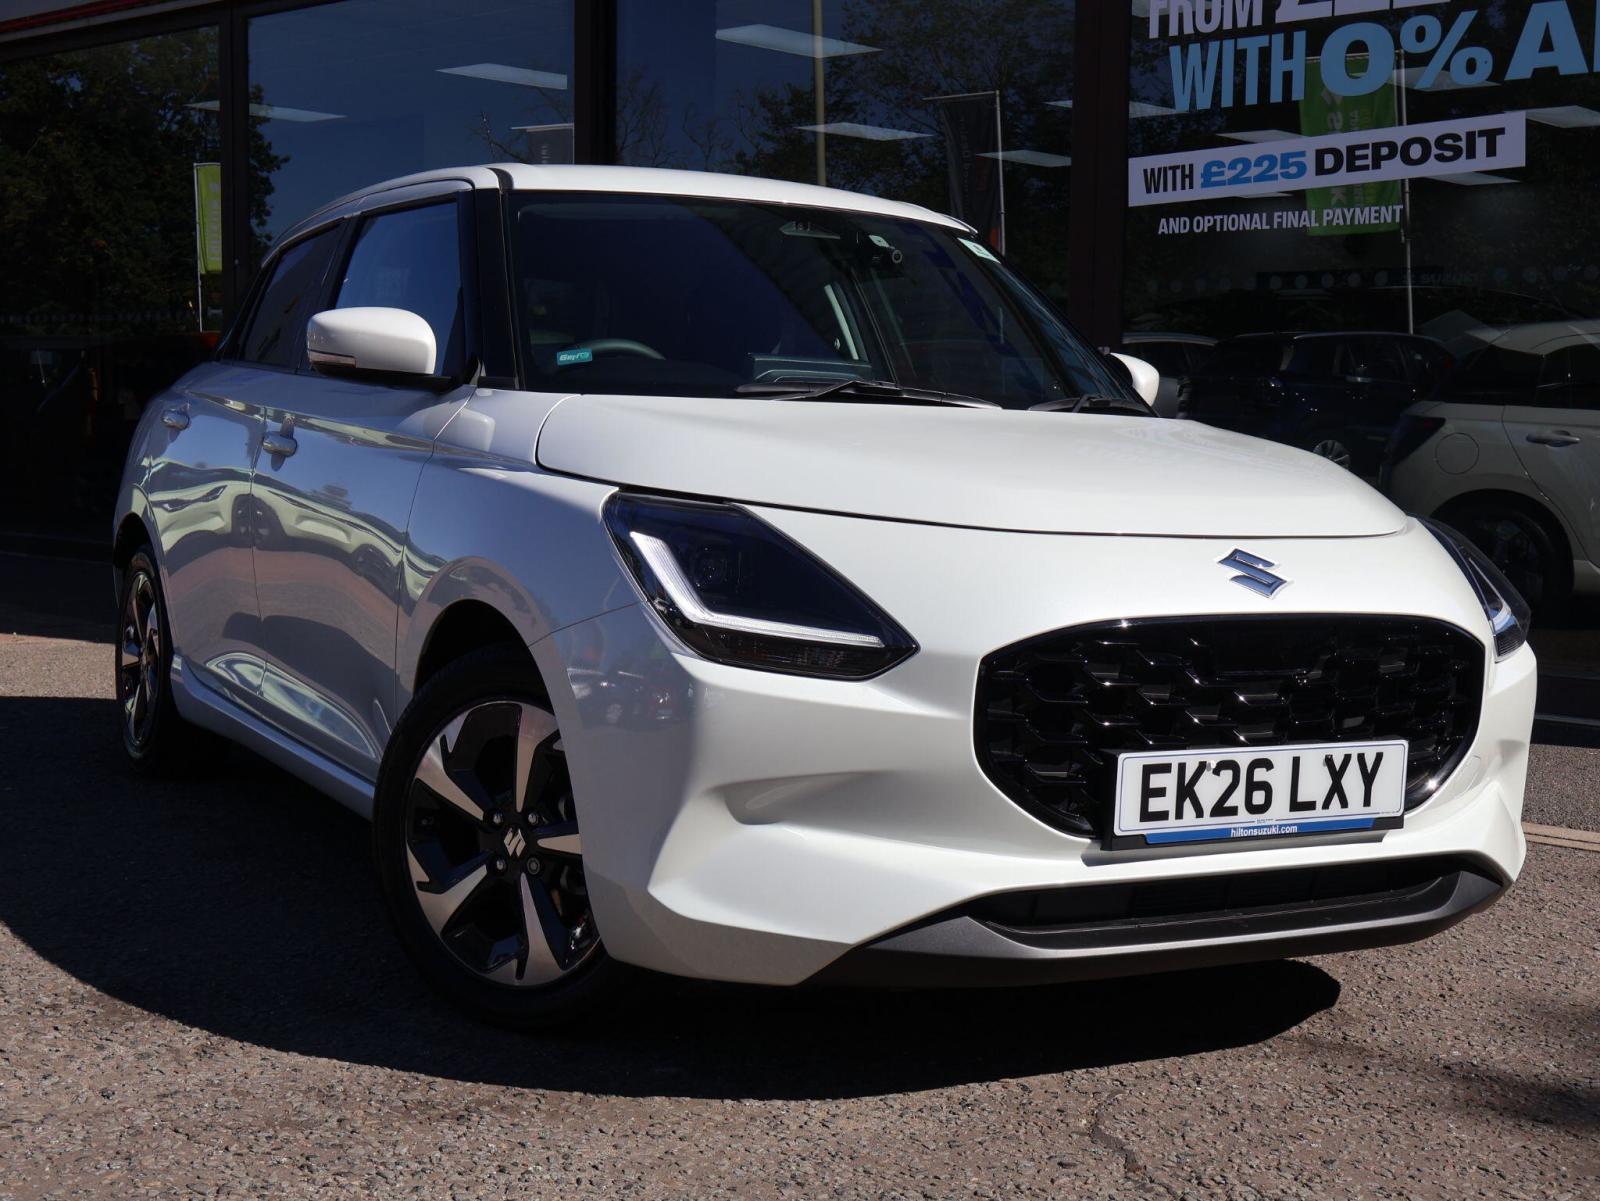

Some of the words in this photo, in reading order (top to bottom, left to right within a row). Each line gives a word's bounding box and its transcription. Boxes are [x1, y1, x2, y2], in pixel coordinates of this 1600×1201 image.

[1169, 30, 1307, 112] WITH
[1320, 10, 1494, 97] 0%
[1504, 0, 1600, 81] A
[1143, 163, 1194, 194] WITH
[1200, 151, 1307, 189] £225
[1315, 127, 1505, 176] DEPOSIT
[1158, 217, 1191, 235] AND
[1192, 213, 1270, 232] OPTIONAL
[1273, 209, 1319, 229] FINAL
[1322, 205, 1403, 226] PAYMENT
[1139, 757, 1275, 823] EK26
[1289, 752, 1384, 812] LXY
[1230, 825, 1298, 838] hiltonsuzuki.com
